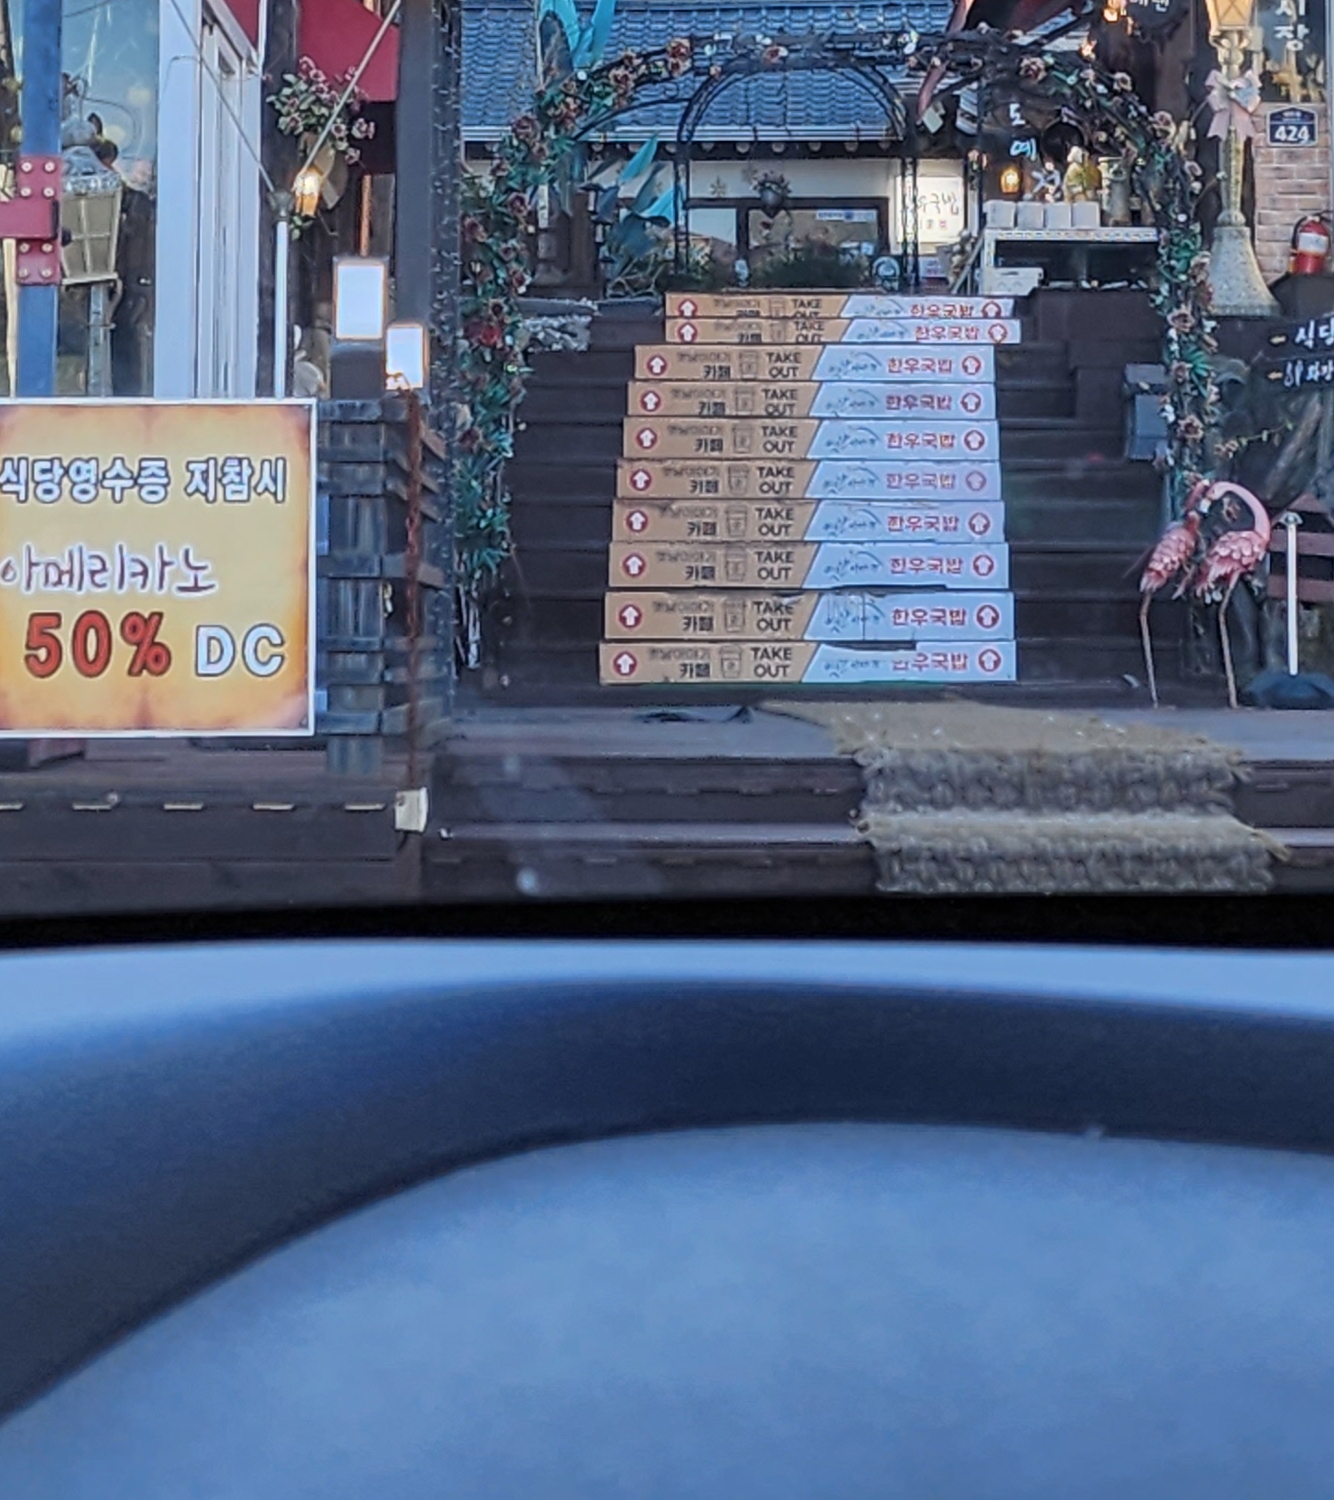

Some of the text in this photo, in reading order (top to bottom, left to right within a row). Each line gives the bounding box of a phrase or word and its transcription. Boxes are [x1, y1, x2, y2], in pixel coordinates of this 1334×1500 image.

[1274, 125, 1310, 144] 424
[791, 299, 823, 308] TAKE
[766, 353, 801, 364] TAKE
[768, 367, 799, 379] OUT
[762, 389, 797, 399] TAKE
[765, 404, 795, 415] OUT
[761, 426, 798, 437] TAKE
[763, 441, 795, 453] OUT
[757, 466, 794, 478] TAKE
[183, 455, 288, 504] 지참시
[886, 473, 956, 489] 한우국밥
[759, 481, 792, 494] OUT
[755, 508, 794, 519] TAKE
[758, 524, 790, 536] OUT
[887, 516, 960, 532] 한우국밥
[755, 551, 794, 563] TAKE
[758, 567, 792, 580] OUT
[752, 601, 794, 614] TAKE
[893, 608, 967, 626] 한우국밥
[756, 618, 792, 632] OUT
[23, 609, 285, 678] 50% DC
[751, 647, 793, 660] TAKE
[754, 664, 789, 678] OUT
